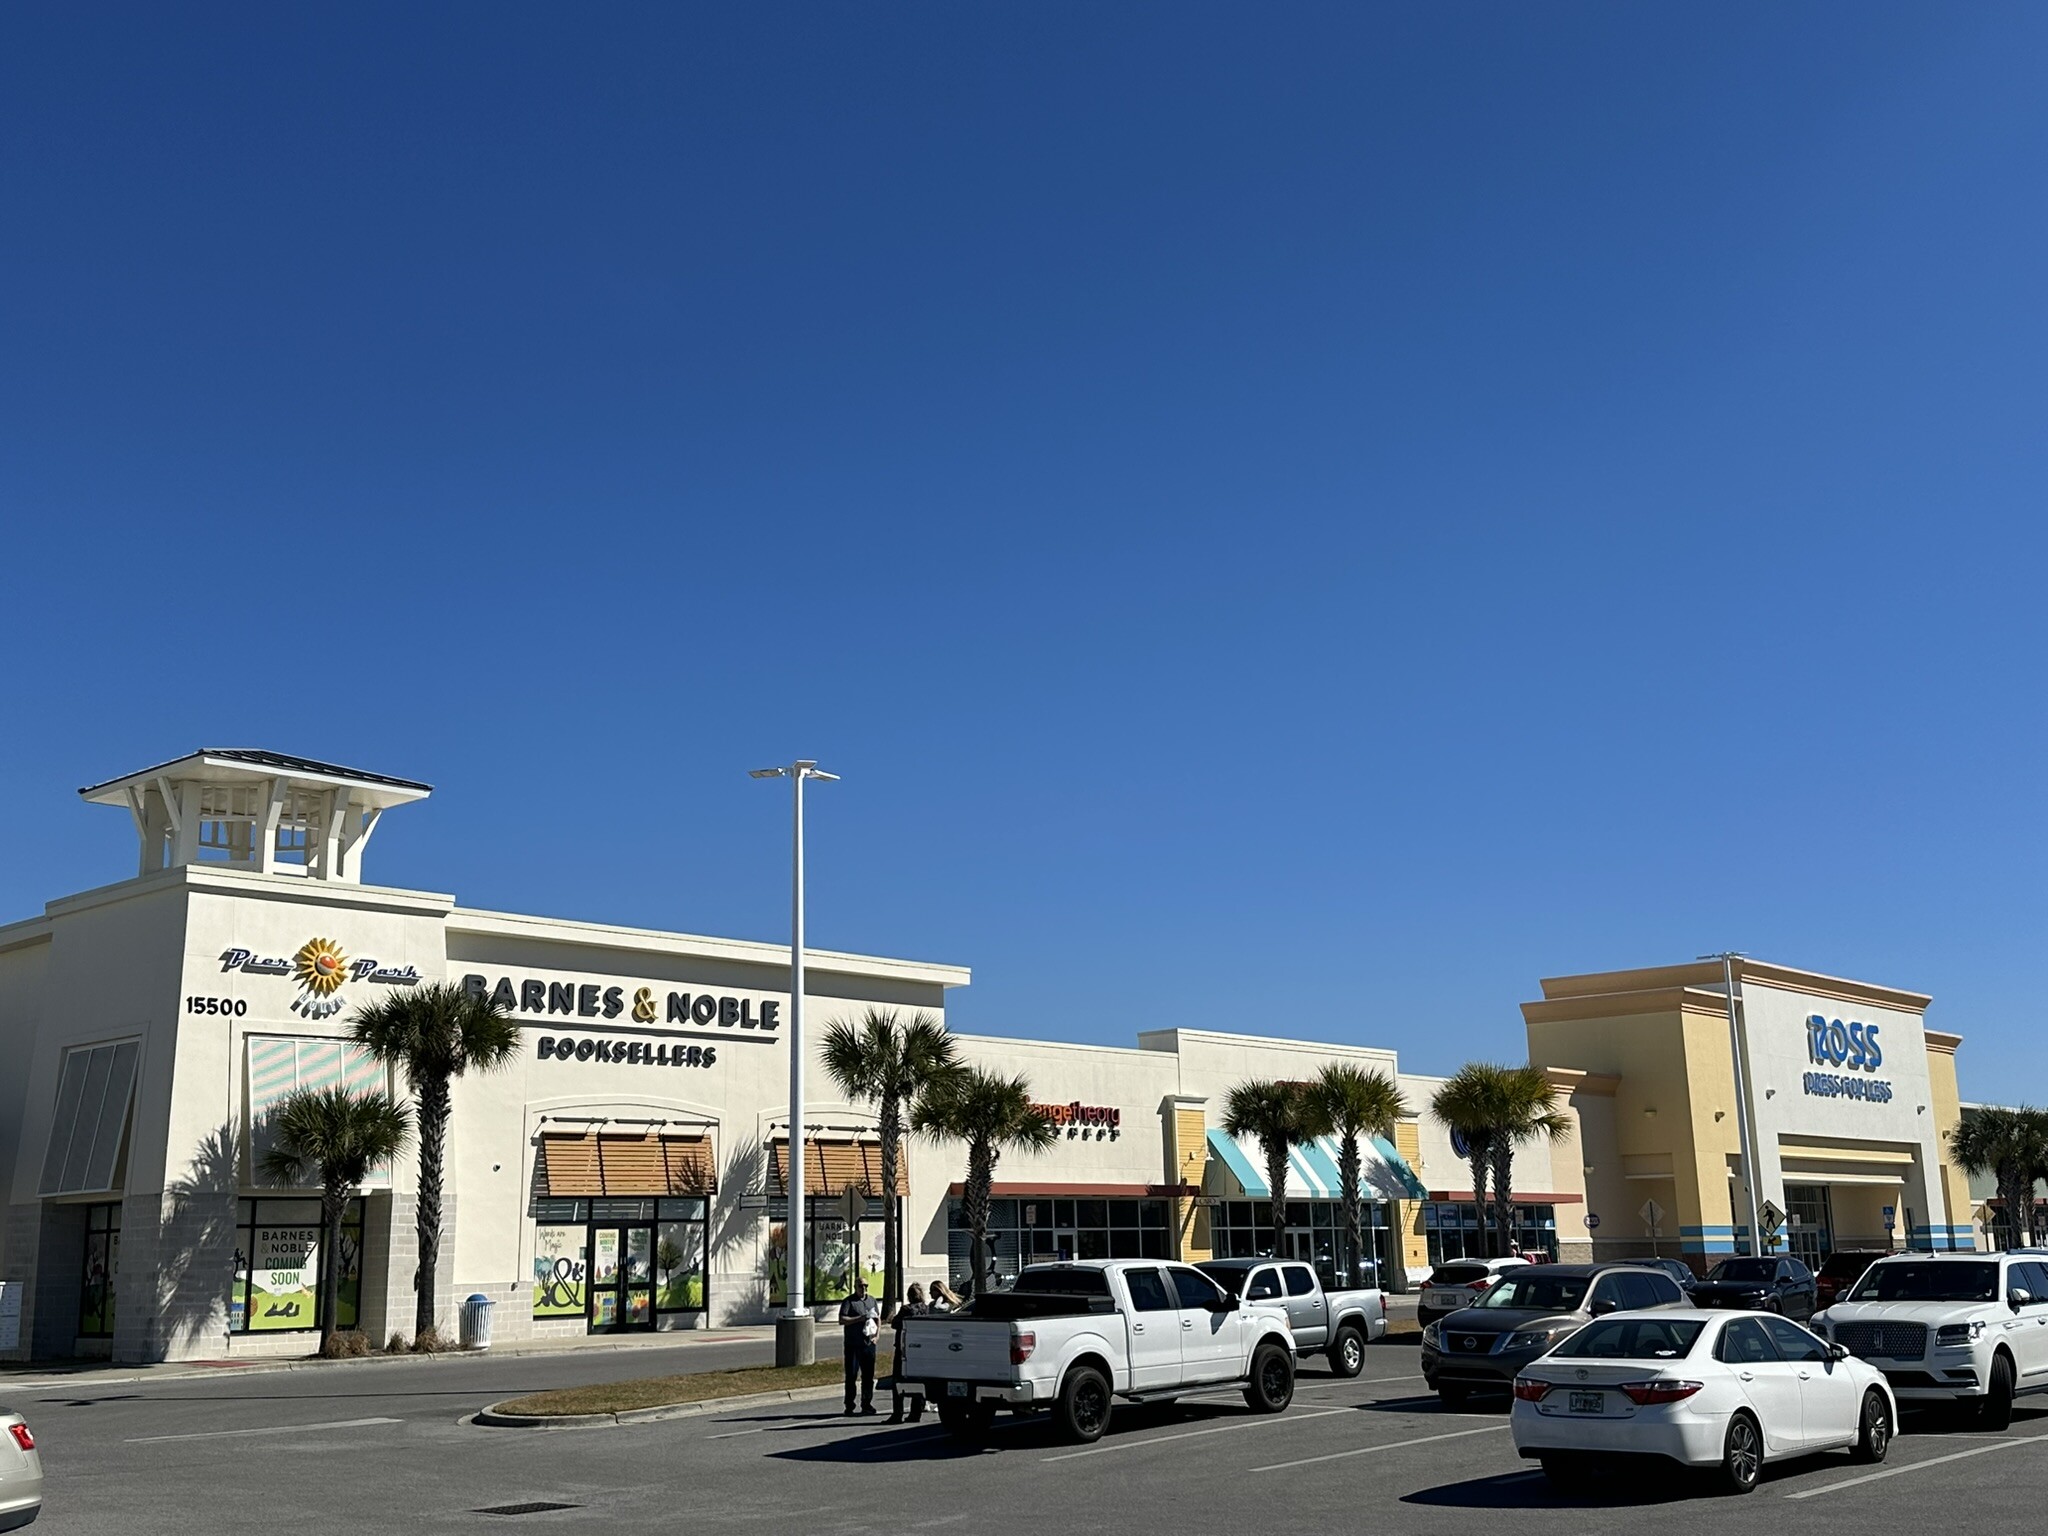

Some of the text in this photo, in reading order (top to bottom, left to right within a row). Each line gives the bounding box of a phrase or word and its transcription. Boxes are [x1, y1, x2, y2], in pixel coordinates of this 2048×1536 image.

[221, 948, 423, 984] Pier Park
[186, 996, 247, 1017] 15500
[462, 974, 780, 1030] BARNES & NOBLE
[537, 1036, 716, 1069] BOOKSELLERS
[1806, 1014, 1882, 1071] ROSS
[1803, 1071, 1892, 1103] DRESS FOR LESS
[1022, 1101, 1120, 1127] angetheory
[262, 1231, 314, 1241] BARNES
[271, 1242, 313, 1254] NOBLE
[265, 1256, 307, 1270] COMING
[271, 1272, 300, 1286] SOON
